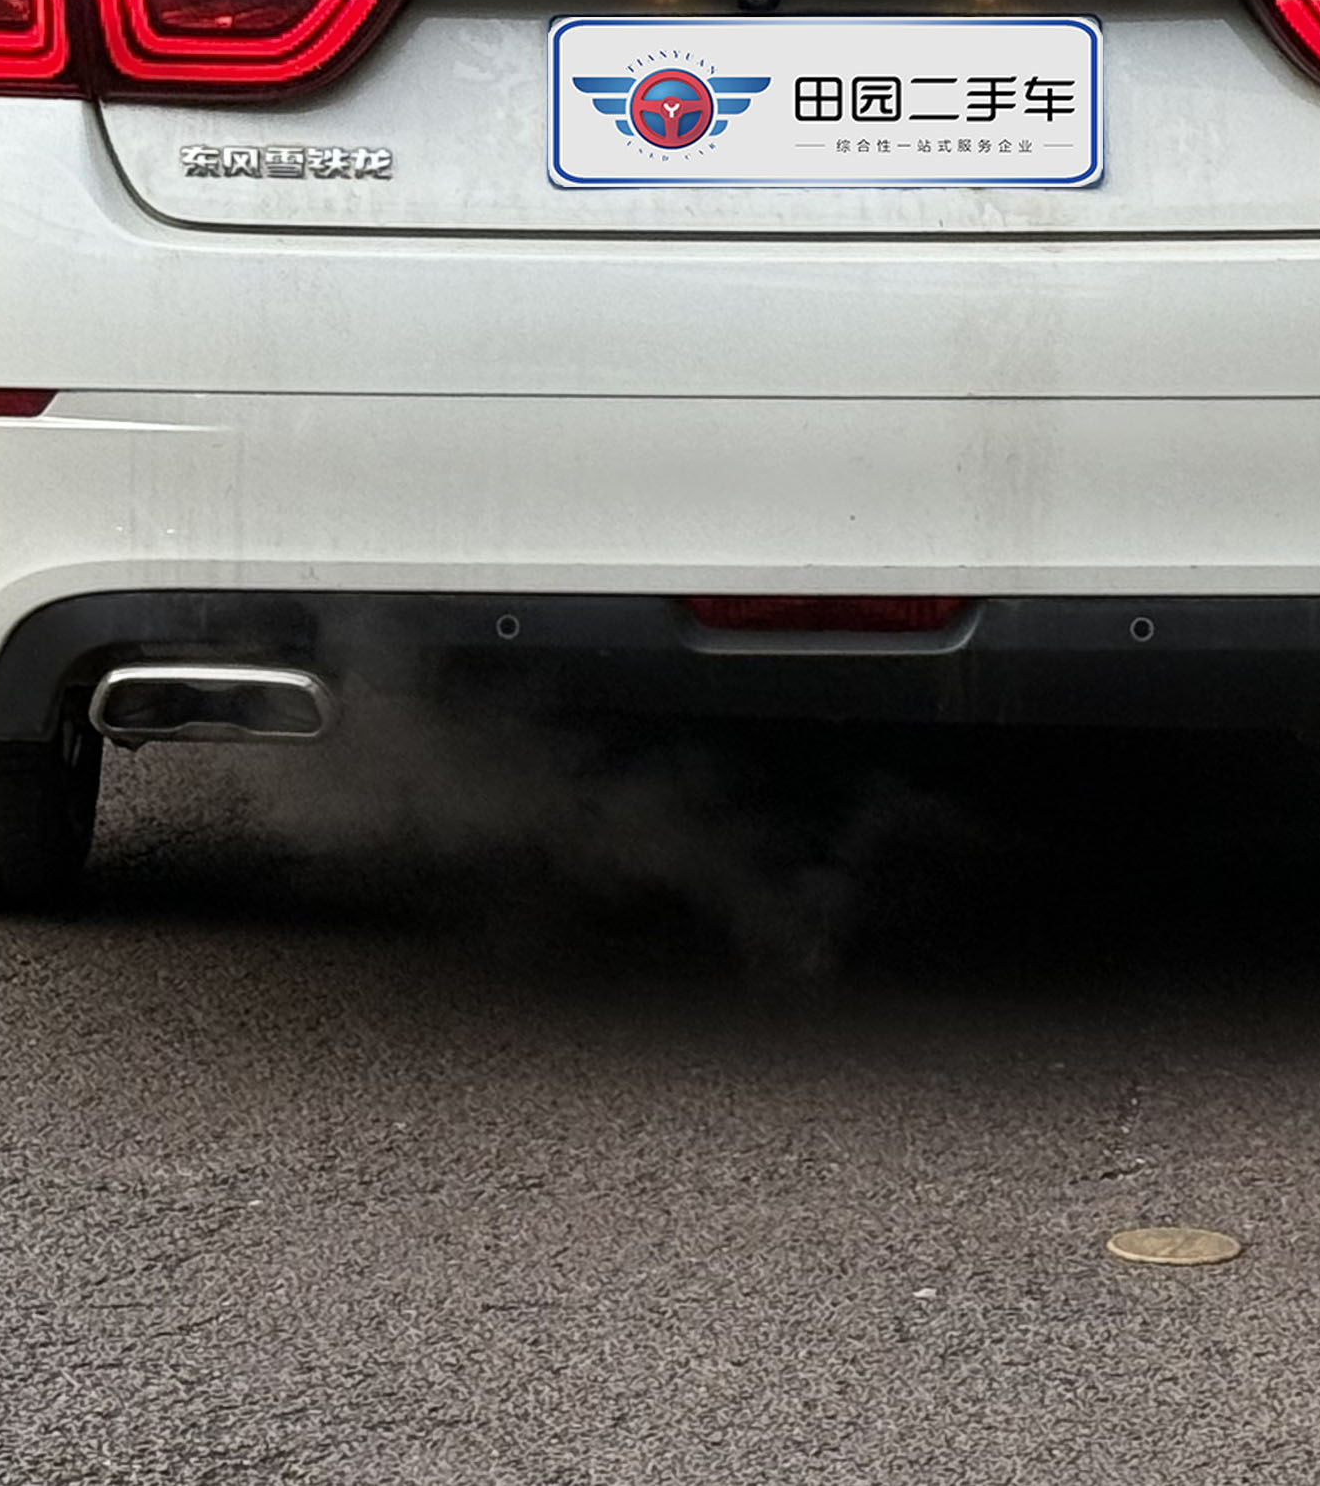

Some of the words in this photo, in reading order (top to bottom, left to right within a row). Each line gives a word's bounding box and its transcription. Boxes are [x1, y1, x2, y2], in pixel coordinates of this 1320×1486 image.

[180, 146, 393, 180] 东风雪铁龙
